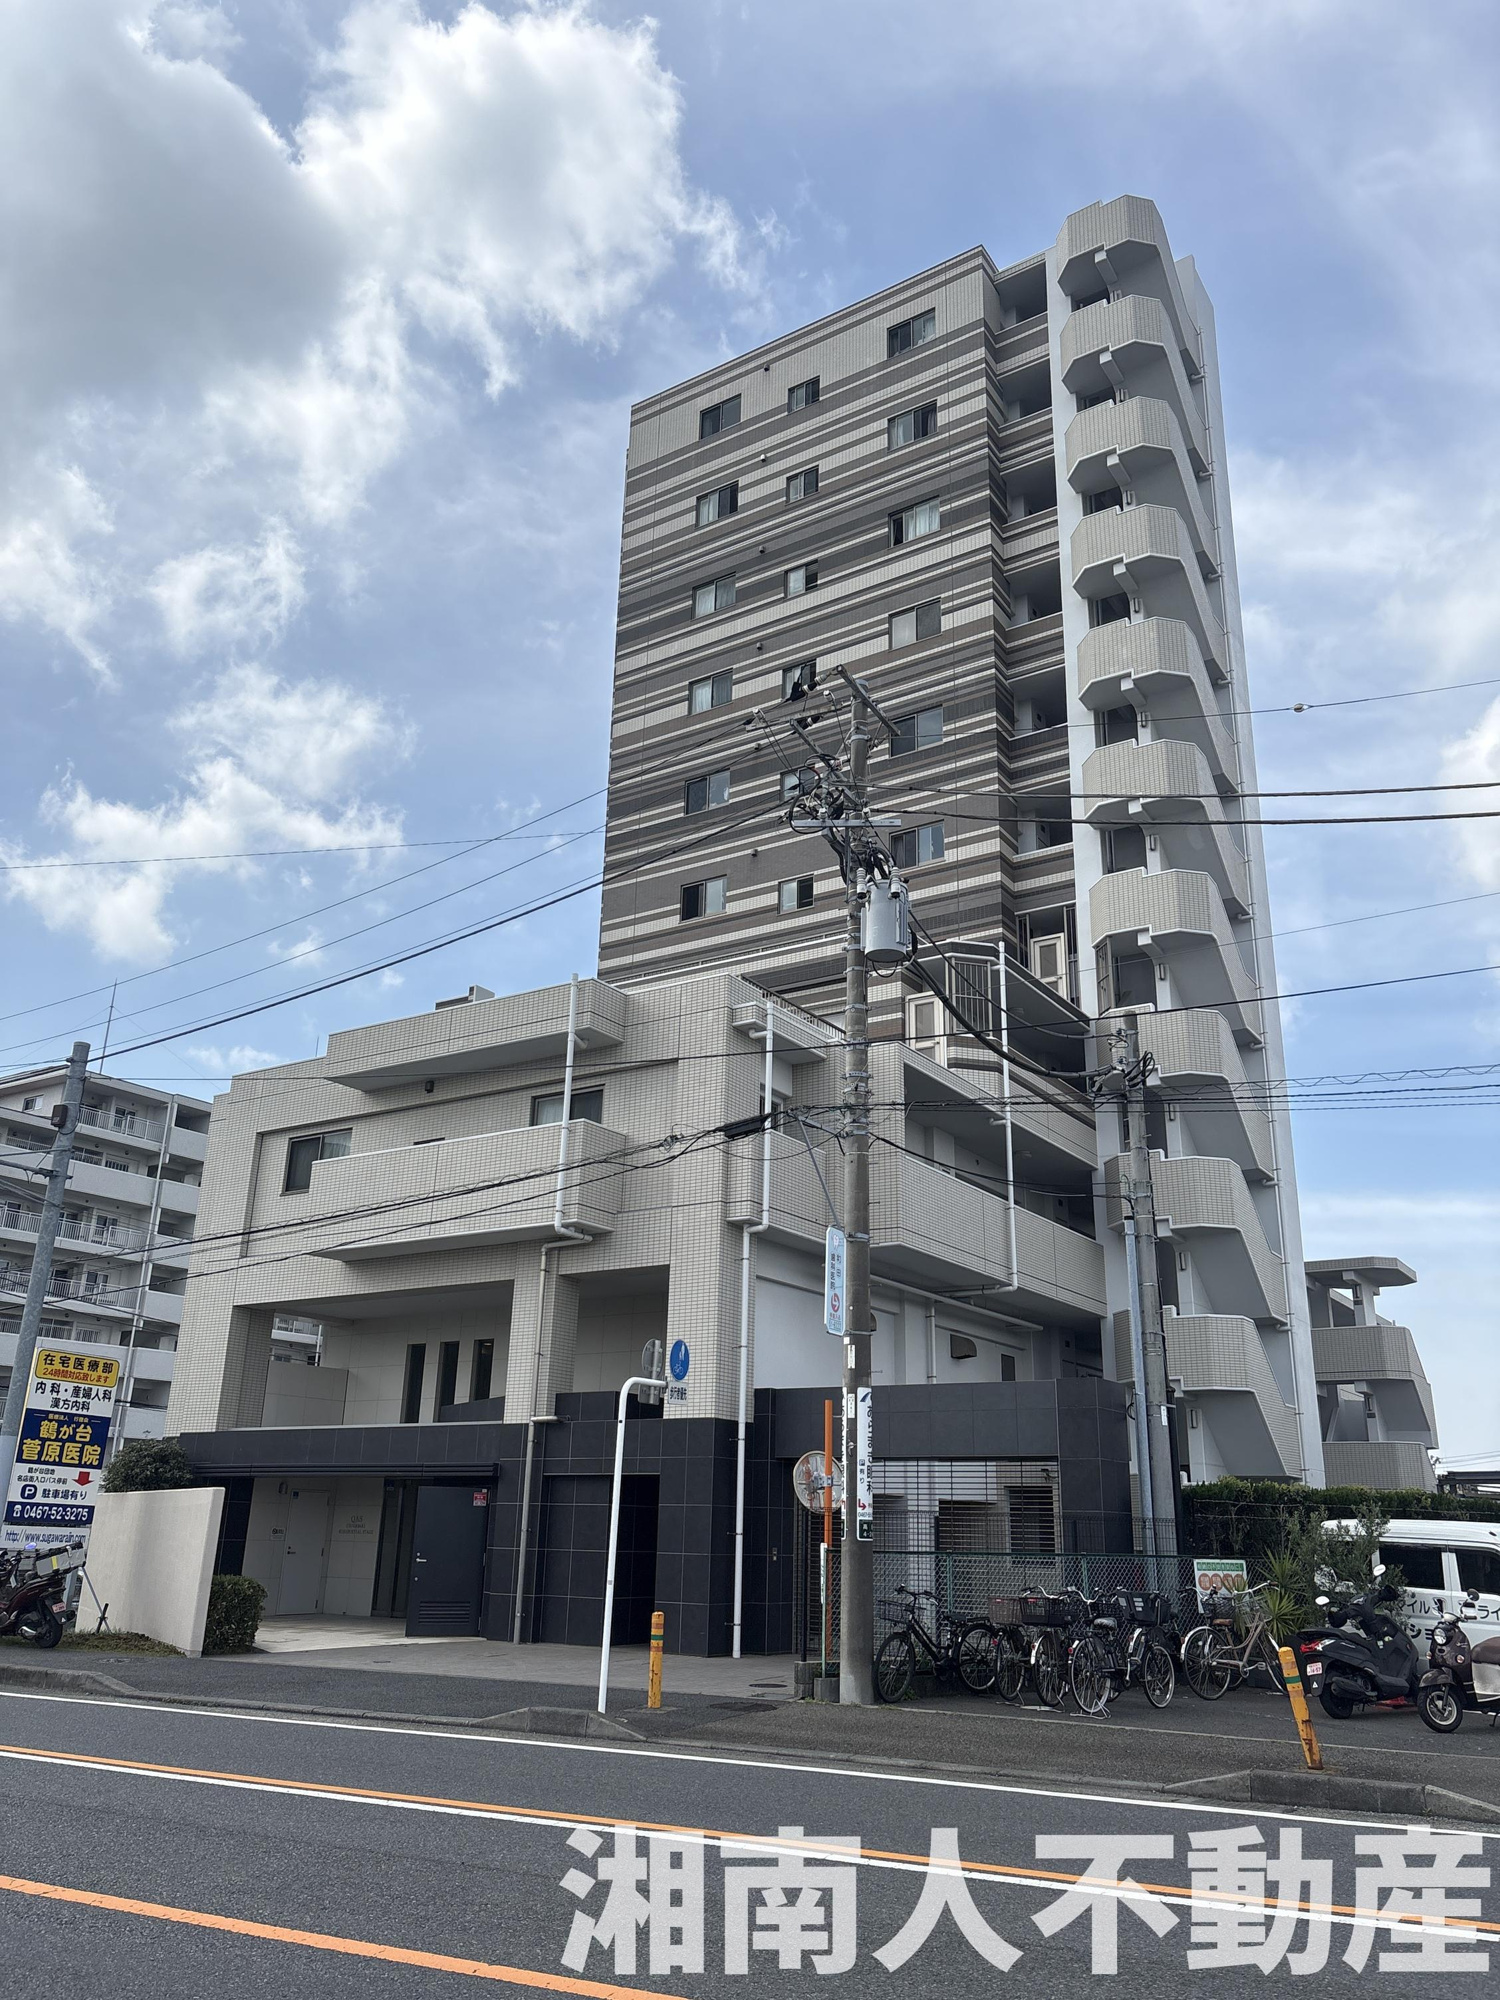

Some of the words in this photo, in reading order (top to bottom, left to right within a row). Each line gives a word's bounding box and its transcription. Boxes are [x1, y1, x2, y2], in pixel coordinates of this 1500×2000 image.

[43, 1353, 114, 1374] 在宅医療部
[42, 1367, 109, 1384] 24時間対応致します
[50, 1396, 91, 1412] 漢方内科
[40, 1420, 92, 1442] 鶴が台
[22, 1438, 101, 1466] 菅原医院
[41, 1488, 87, 1501] 駐車場有り
